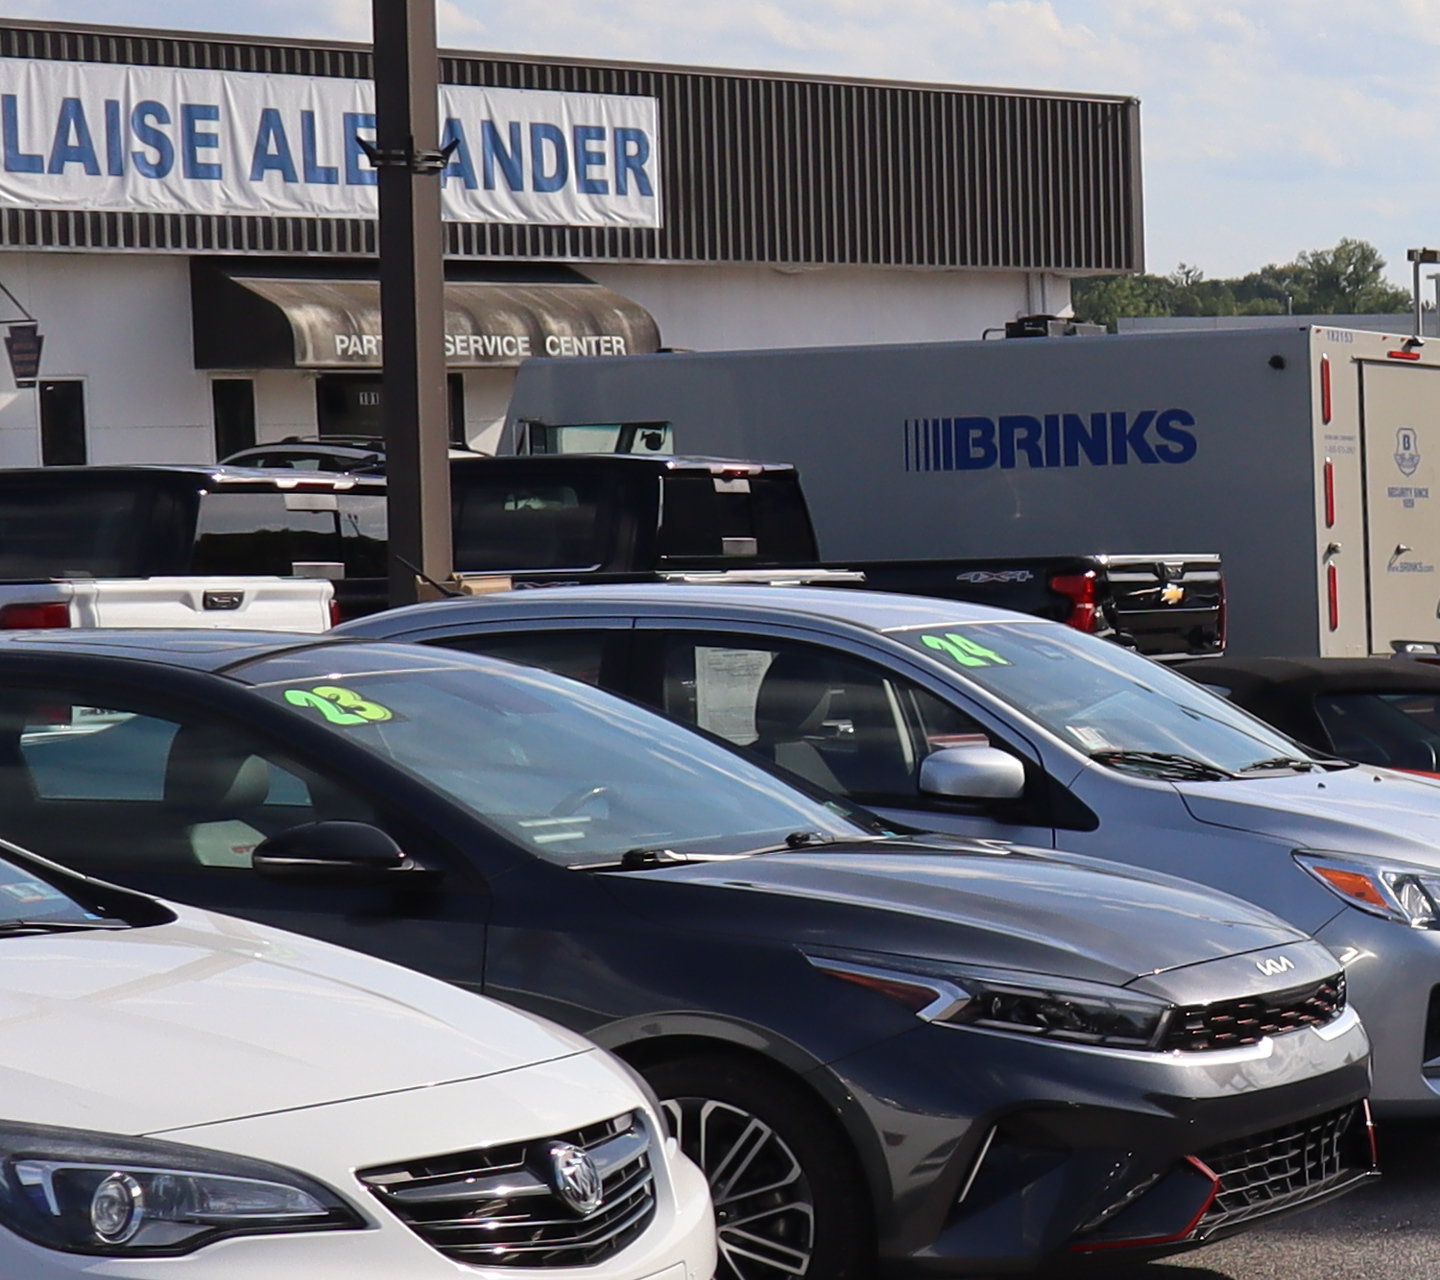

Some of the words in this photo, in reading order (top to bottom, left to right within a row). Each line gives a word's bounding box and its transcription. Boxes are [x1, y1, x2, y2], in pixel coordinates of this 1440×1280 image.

[250, 108, 654, 197] ALEANDER
[445, 334, 532, 357] SERVICE
[545, 335, 627, 356] CENTER
[952, 408, 1198, 472] BRINKS
[920, 632, 1013, 667] 24
[283, 685, 393, 726] 23
